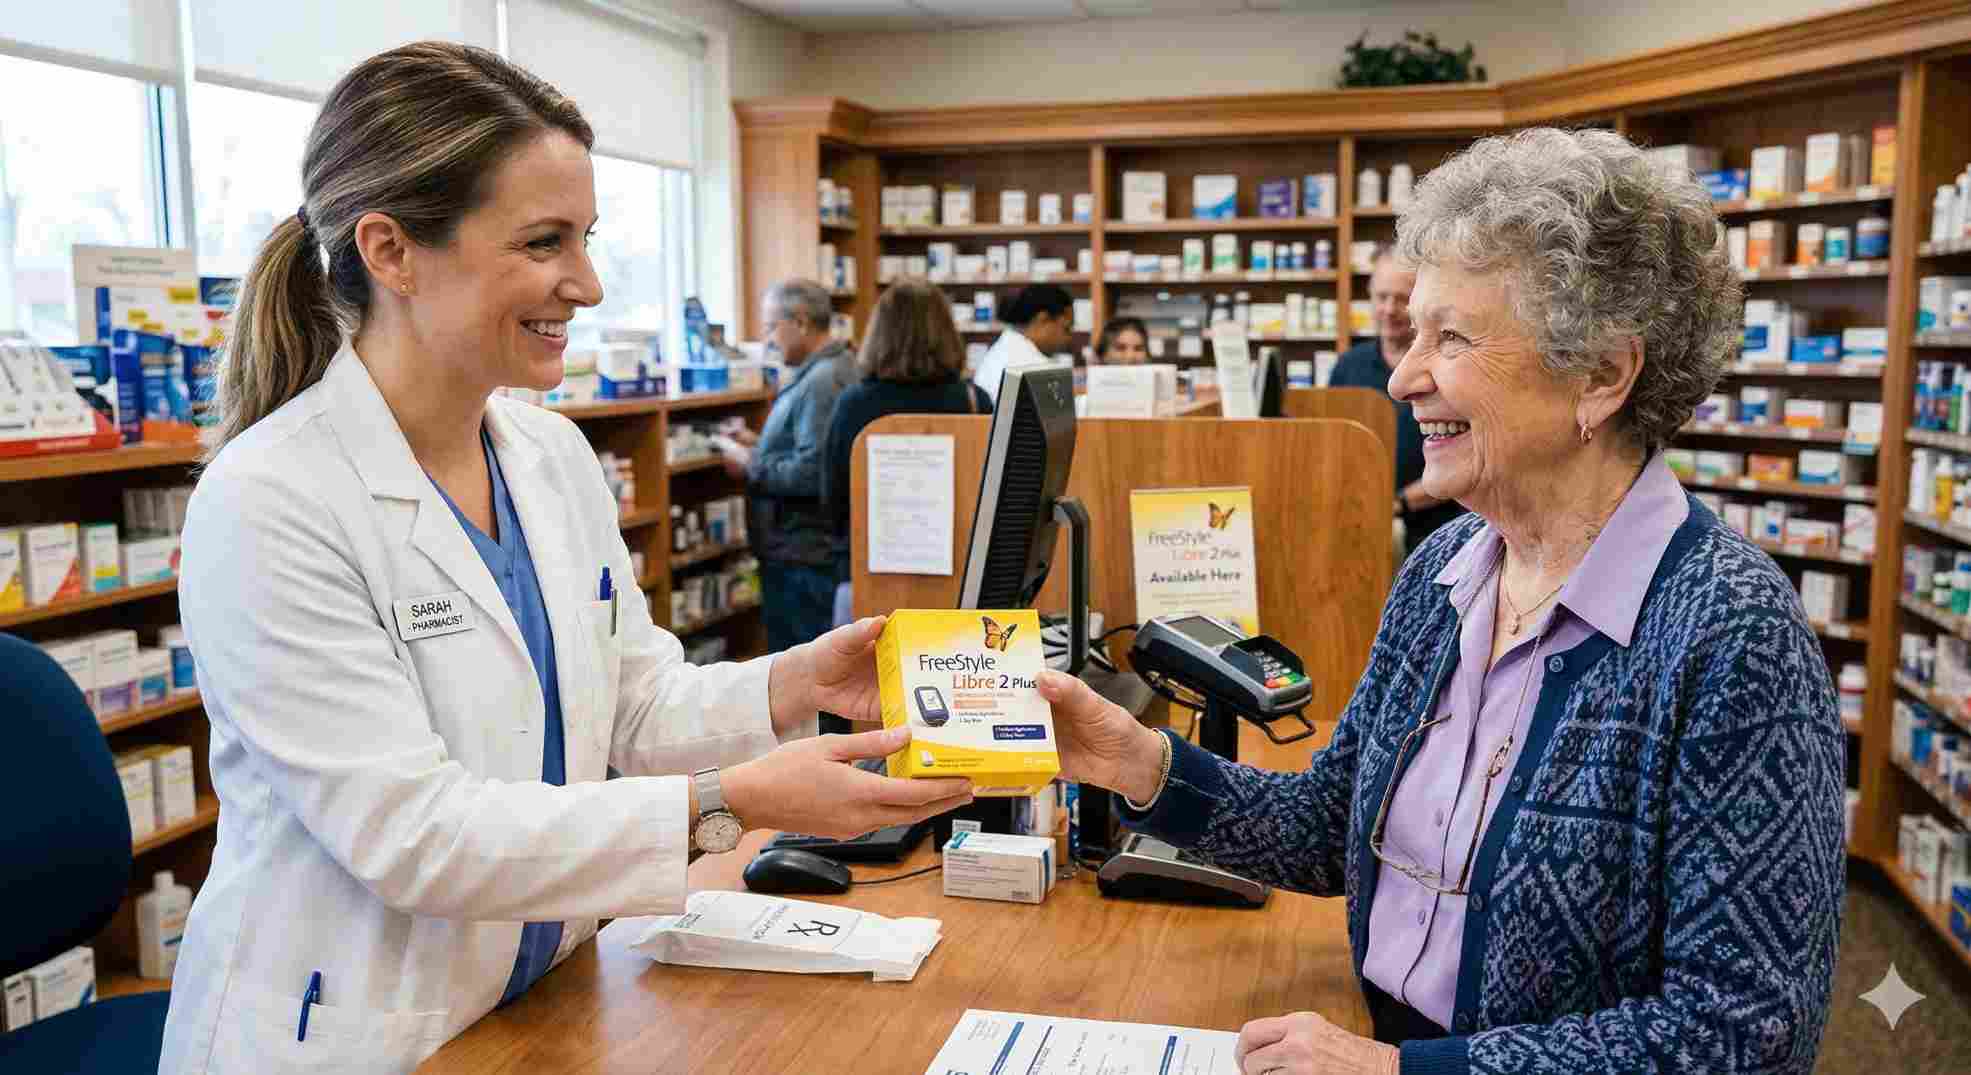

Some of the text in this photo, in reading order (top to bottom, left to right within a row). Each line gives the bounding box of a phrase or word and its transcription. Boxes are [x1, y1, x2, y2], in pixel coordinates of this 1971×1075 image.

[1210, 546, 1218, 560] 2
[1150, 568, 1241, 583] Available Here
[411, 600, 452, 618] SARAH
[412, 615, 464, 633] PHARMACIST
[919, 654, 996, 674] FreeStyle
[952, 674, 1037, 689] Libre 2 Plus
[787, 920, 840, 937] Rx
